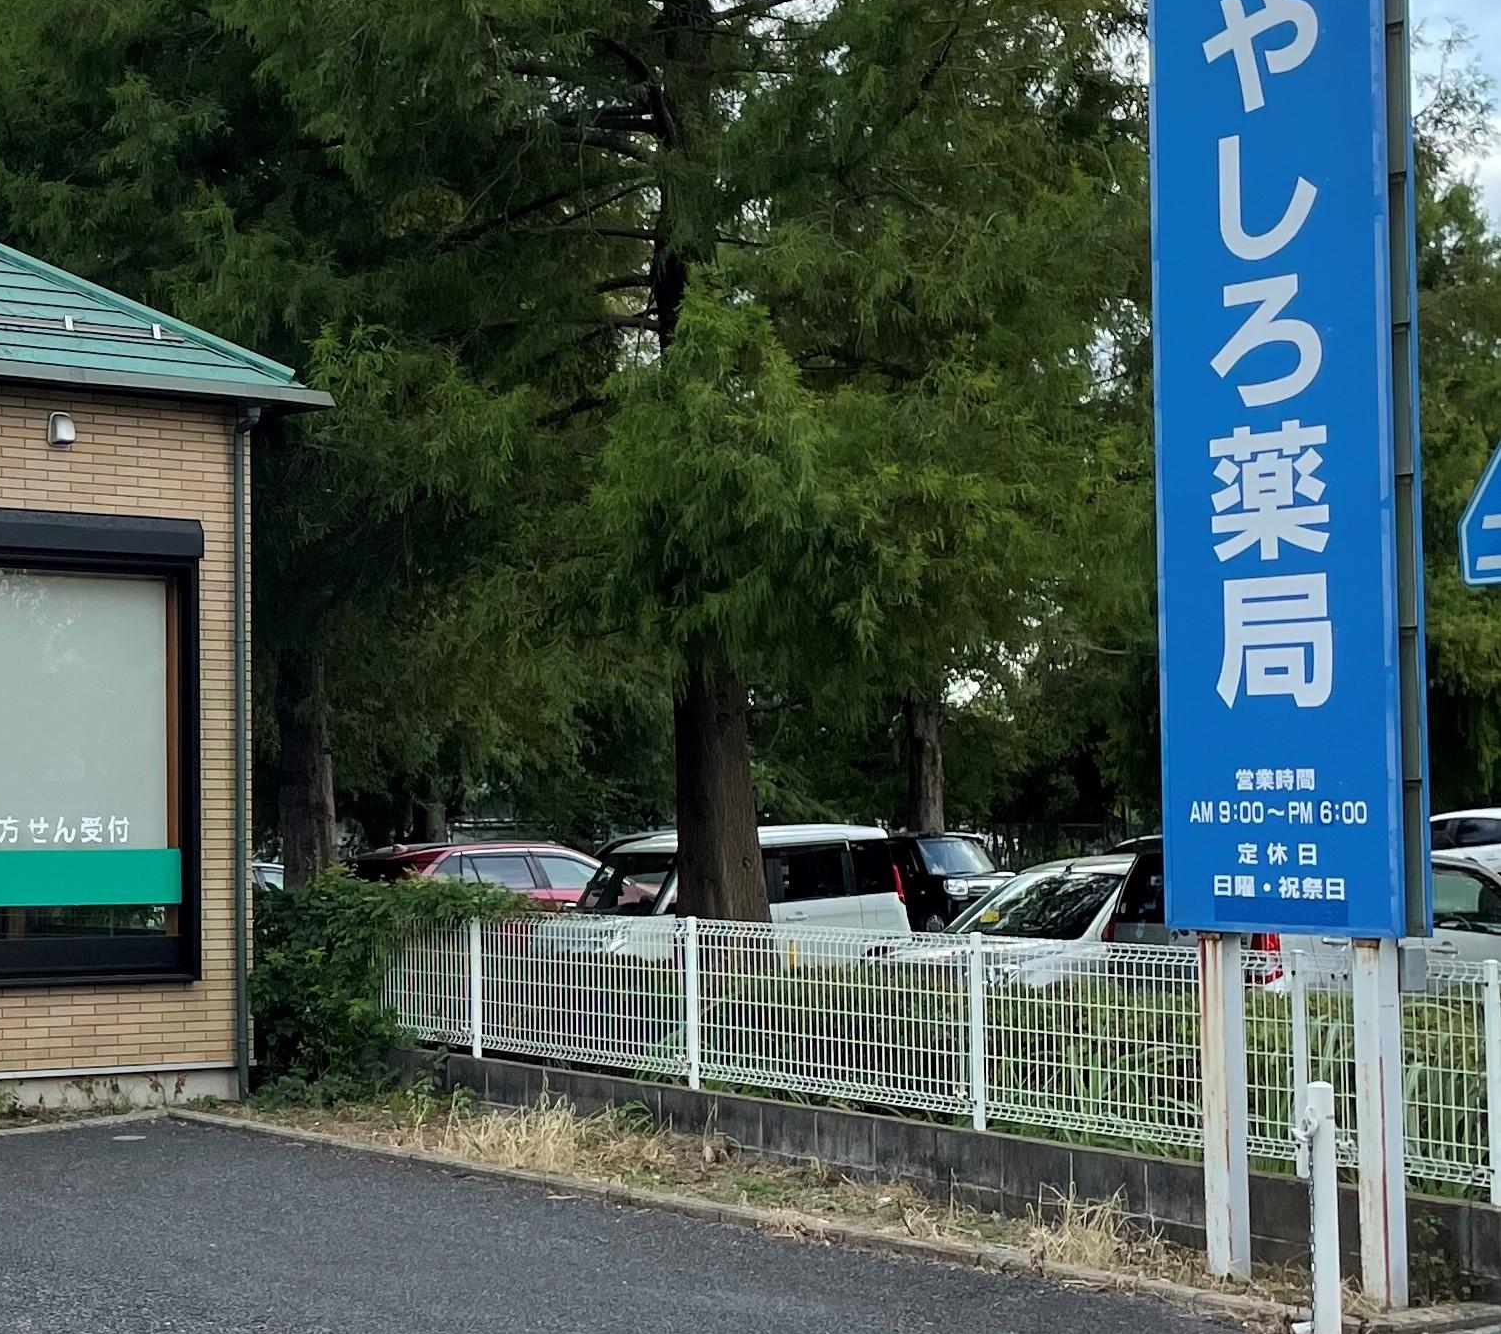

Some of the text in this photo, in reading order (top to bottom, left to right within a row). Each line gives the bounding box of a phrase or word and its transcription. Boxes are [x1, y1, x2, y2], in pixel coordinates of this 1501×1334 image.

[1235, 768, 1315, 791] 営業時間
[1189, 800, 1214, 823] AM
[1319, 800, 1368, 825] 6:00
[1213, 874, 1346, 901] 日曜・祝祭日
